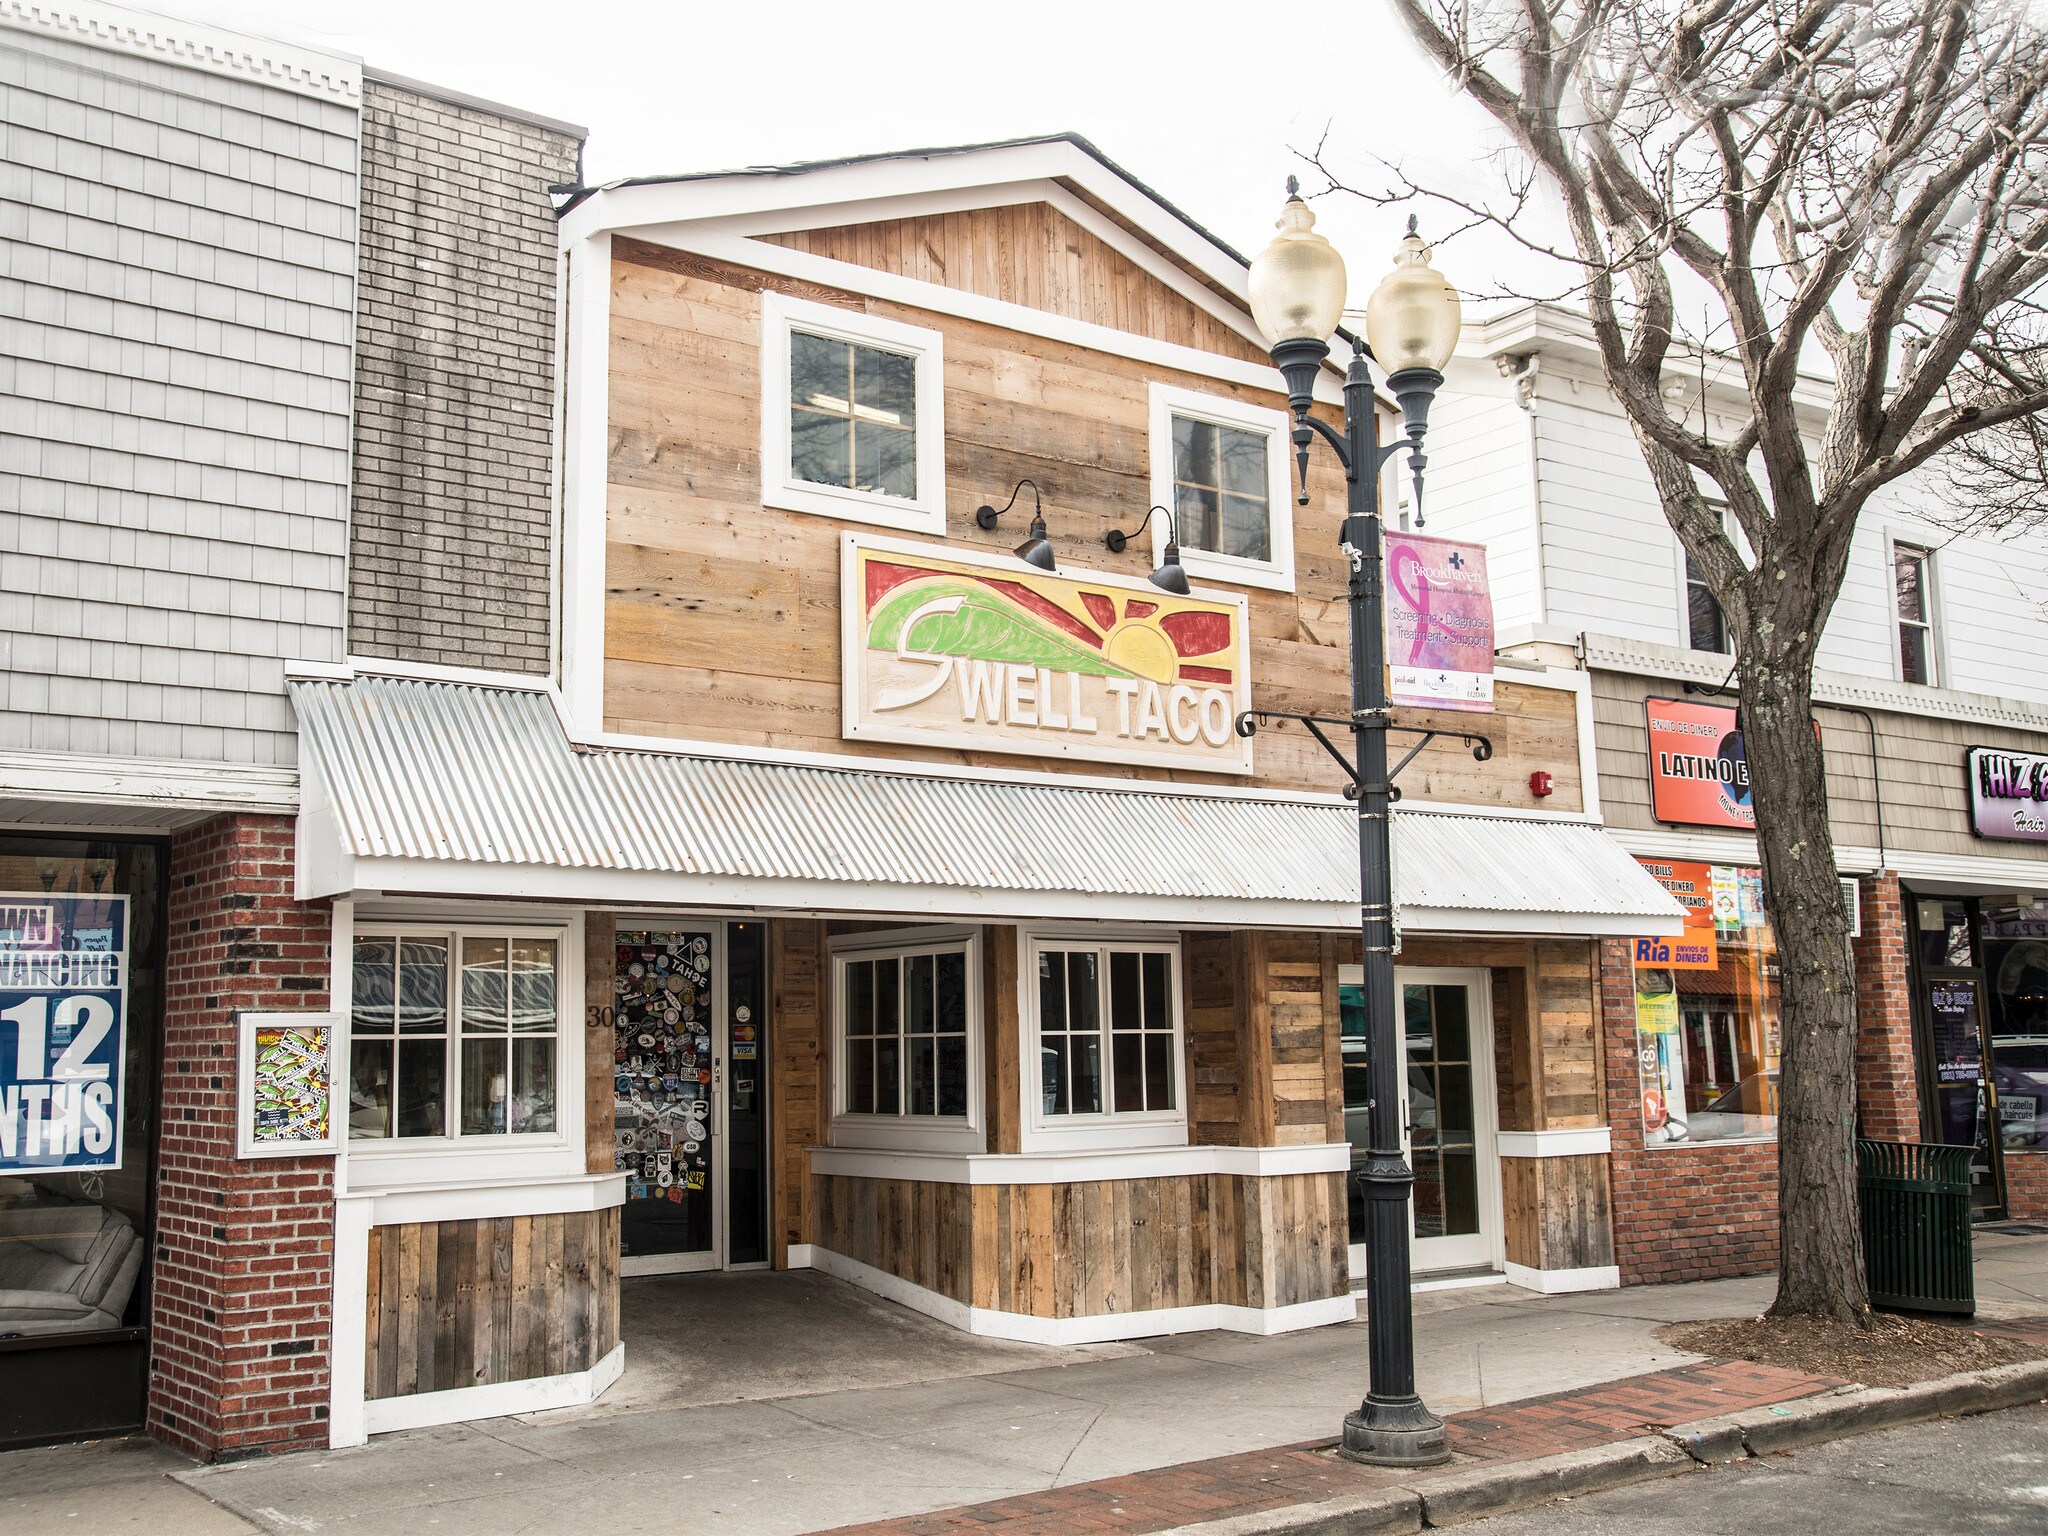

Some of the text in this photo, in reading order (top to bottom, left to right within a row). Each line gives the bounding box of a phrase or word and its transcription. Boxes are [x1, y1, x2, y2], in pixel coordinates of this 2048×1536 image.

[1411, 561, 1482, 584] Brookhaven
[1392, 607, 1490, 629] Screening Diagnosis
[1396, 626, 1487, 647] Treatment Support
[872, 594, 1232, 748] SWELL TACO
[1651, 718, 1719, 738] ENVIO DE DINERO
[1660, 752, 1749, 785] LATINO E
[1979, 755, 2031, 799] HIZ
[1719, 794, 1755, 822] MONEY TRA
[2013, 809, 2045, 832] Hair
[1655, 864, 1672, 876] BILLS
[1672, 881, 1695, 893] DINERO
[1674, 895, 1706, 908] TORIANOS
[1636, 937, 1670, 962] Ria
[1676, 954, 1709, 963] DINERO
[672, 959, 707, 988] TAHOE
[587, 1005, 614, 1028] 30
[1, 994, 114, 1080] 12
[2004, 1110, 2033, 1119] haircuts
[2009, 1101, 2033, 1110] cabello
